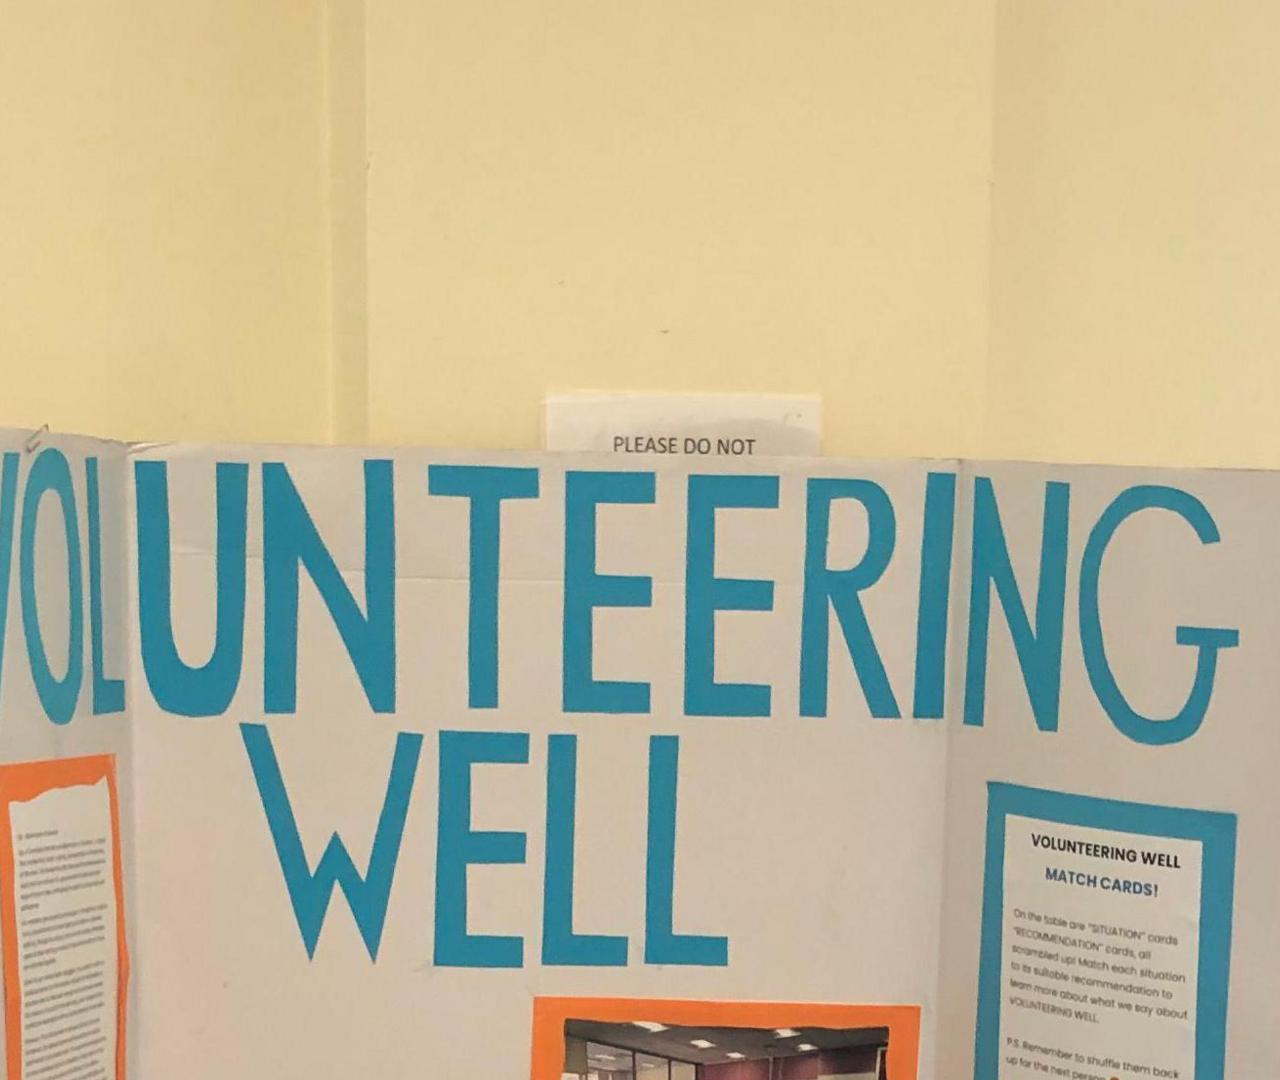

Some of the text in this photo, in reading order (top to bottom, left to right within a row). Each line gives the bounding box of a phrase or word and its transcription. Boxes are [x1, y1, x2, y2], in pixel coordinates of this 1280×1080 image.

[613, 436, 756, 455] PLEASE DO NOT
[239, 723, 728, 969] WELL
[1031, 834, 1181, 869] VOLUNTEERING WELL
[1045, 867, 1159, 898] MATCH CARDS!
[1013, 908, 1026, 919] On
[1027, 911, 1042, 922] the
[1043, 914, 1068, 927] table
[1069, 921, 1086, 931] are
[1147, 933, 1179, 946] cards
[1078, 957, 1109, 971] Match
[1111, 962, 1138, 975] each
[1139, 968, 1186, 983] situation
[1138, 951, 1152, 960] all
[1010, 961, 1020, 971] to
[1071, 974, 1160, 998] recommendation
[1161, 989, 1173, 1000] to
[1009, 996, 1073, 1018] VOLUNTEERING
[1033, 985, 1059, 997] more
[1059, 989, 1089, 1002] about
[1089, 995, 1120, 1008] what
[1117, 1001, 1133, 1012] we
[1134, 1003, 1154, 1017] say
[1155, 1006, 1188, 1020] about
[1006, 1056, 1018, 1067] up
[1019, 1057, 1032, 1069] for
[1033, 1060, 1049, 1073] the
[1050, 1065, 1071, 1077] next
[1022, 1040, 1073, 1060] Remember
[1074, 1052, 1086, 1064] to
[1086, 1055, 1121, 1070] shuffle
[1122, 1062, 1151, 1076] them
[1152, 1066, 1180, 1079] back
